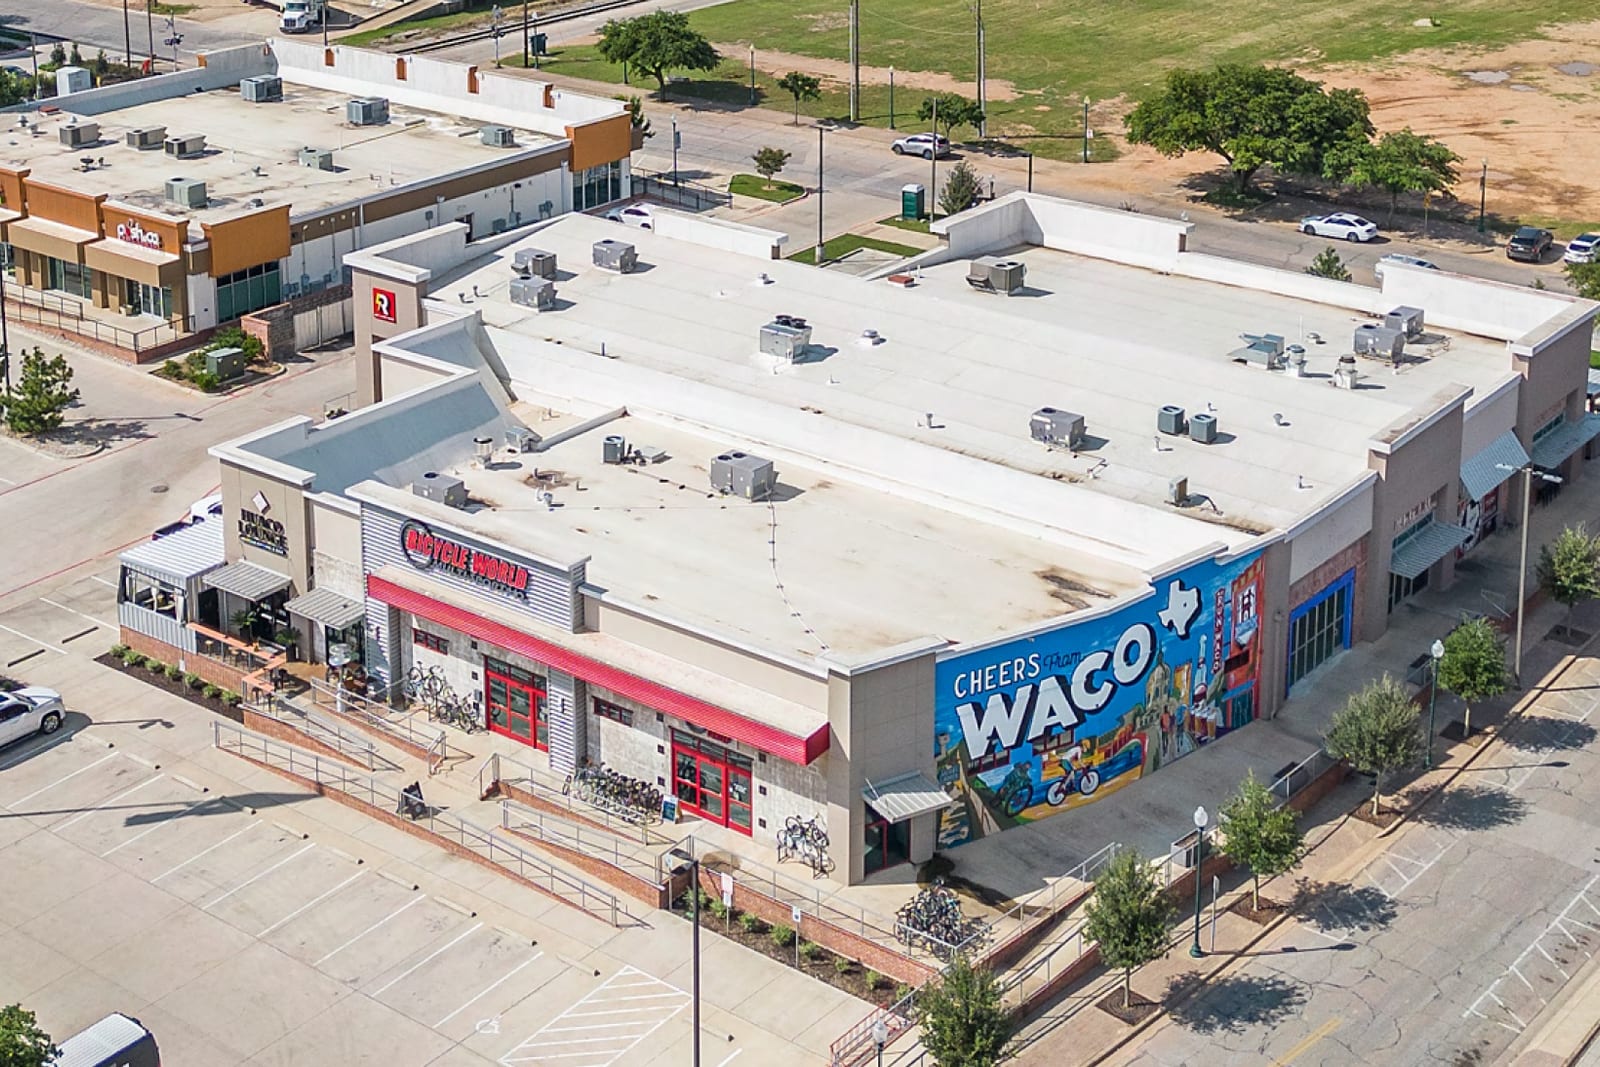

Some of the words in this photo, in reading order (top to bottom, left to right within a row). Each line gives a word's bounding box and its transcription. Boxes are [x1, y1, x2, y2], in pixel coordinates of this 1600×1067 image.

[238, 520, 289, 551] LOUNGE
[405, 528, 468, 569] BICYCLE
[472, 552, 528, 590] WORLD
[954, 653, 1040, 698] CHEERS
[1043, 651, 1085, 670] From
[956, 622, 1156, 760] WACO
